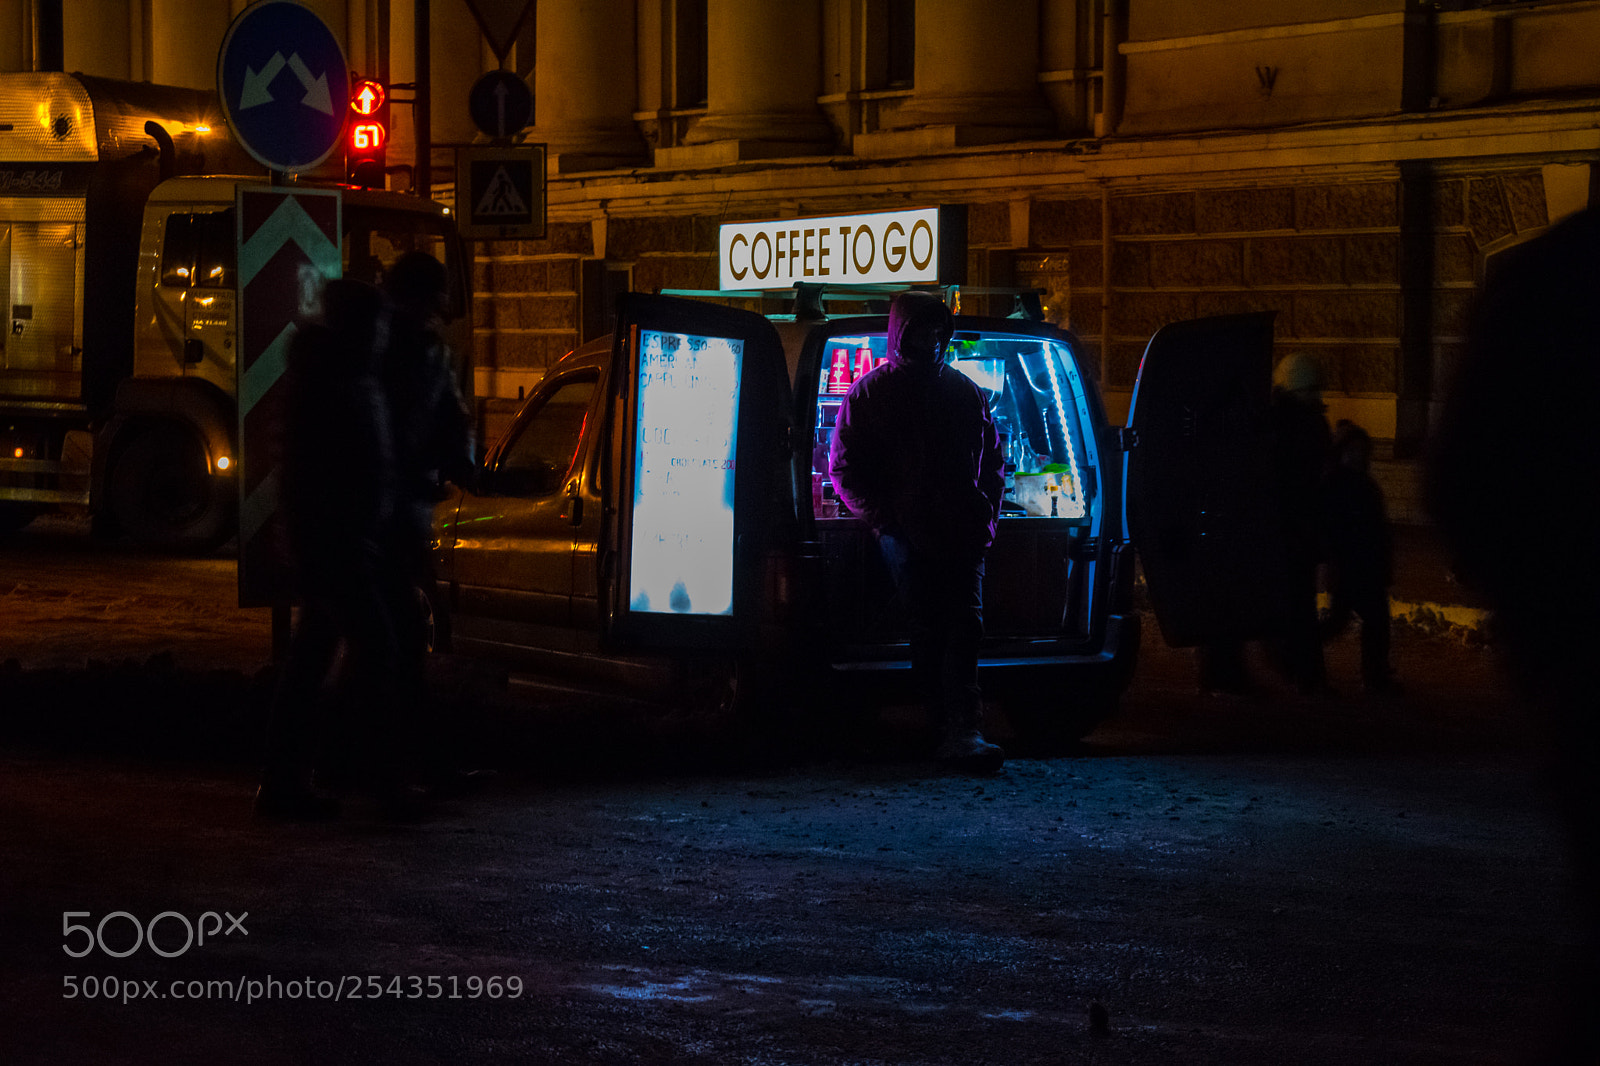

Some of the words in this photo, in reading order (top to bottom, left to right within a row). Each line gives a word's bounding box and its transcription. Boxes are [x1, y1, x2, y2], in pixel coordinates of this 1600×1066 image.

[354, 125, 380, 149] 67
[729, 228, 830, 281] COFFEE
[840, 224, 875, 275] TO
[883, 219, 933, 273] GO
